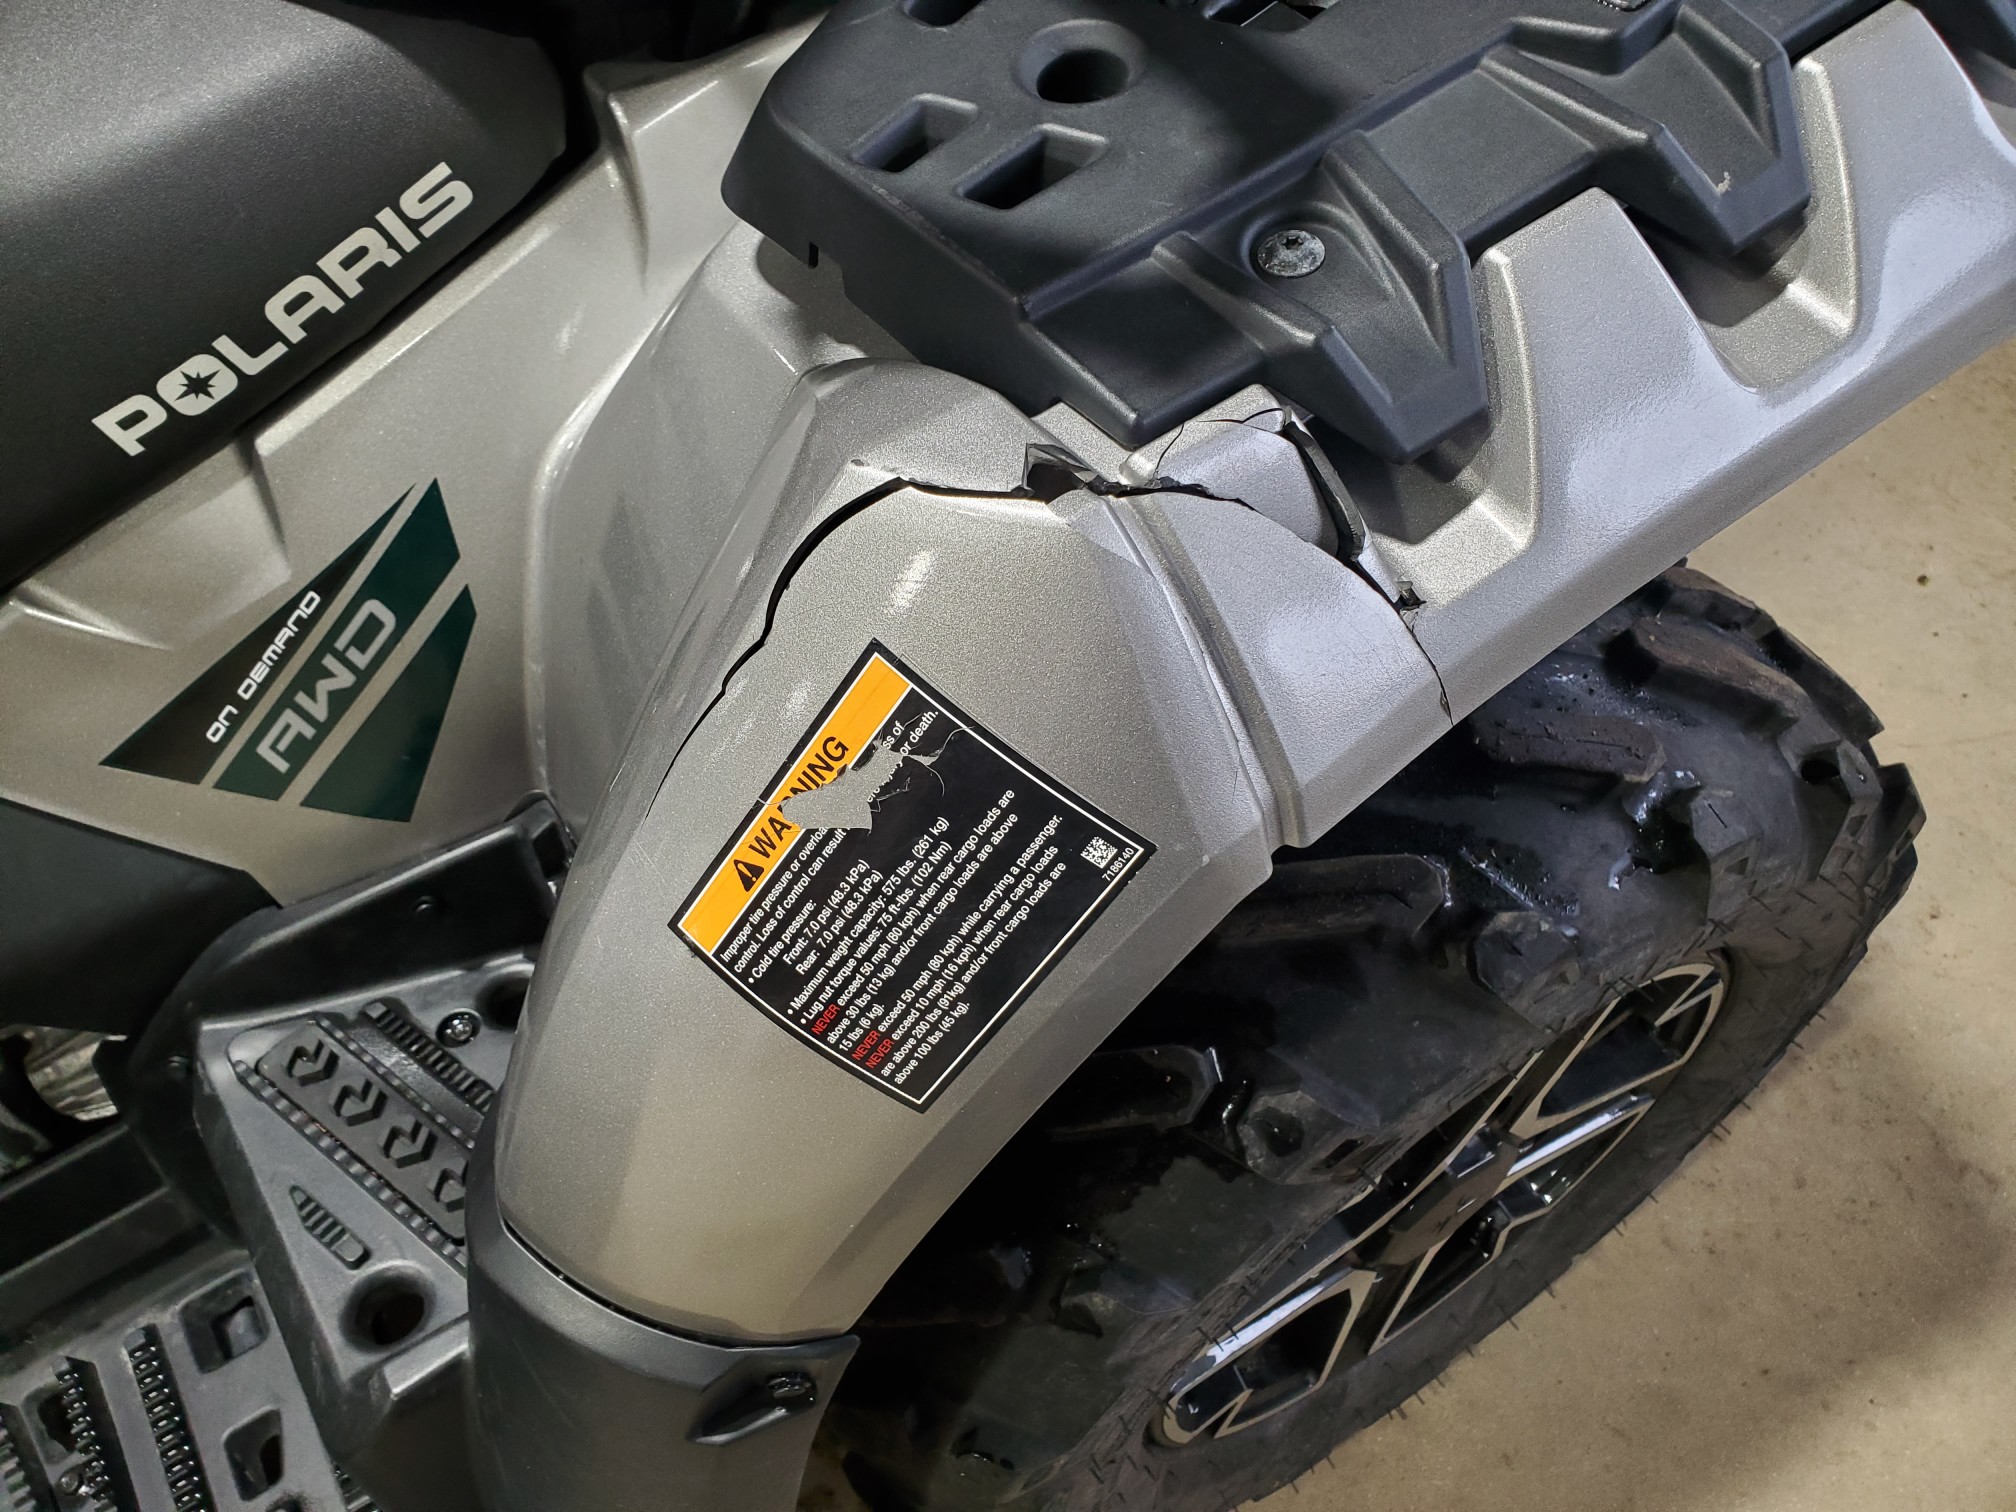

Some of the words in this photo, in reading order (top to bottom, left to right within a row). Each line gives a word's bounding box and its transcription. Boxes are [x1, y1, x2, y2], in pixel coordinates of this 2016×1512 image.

[91, 161, 473, 457] POLARIS
[206, 704, 239, 744] ON
[237, 590, 321, 700] DEMAND
[256, 598, 397, 774] AWD
[719, 921, 753, 963] Improper
[748, 908, 765, 925] tire
[760, 870, 793, 913] pressure
[789, 858, 801, 872] or
[798, 821, 830, 861] overloa
[893, 720, 905, 737] of
[733, 939, 762, 973] control.
[755, 917, 778, 943] Loss
[774, 904, 787, 920] of
[783, 872, 811, 909] control
[807, 856, 826, 877] can
[821, 825, 847, 859] result
[900, 743, 912, 756] or
[910, 709, 939, 743] death.
[782, 936, 810, 965] Front:
[802, 920, 821, 938] 7.0
[816, 904, 833, 925] psi
[827, 881, 851, 909] (48.3
[845, 858, 870, 885] kPa)
[789, 966, 830, 1011] Maximum
[824, 935, 854, 968] weight
[849, 894, 887, 938] capacity:
[881, 873, 902, 896] 575
[895, 859, 917, 878] lbs.
[911, 834, 934, 859] (261
[928, 816, 950, 837] kg)
[794, 949, 821, 976] Rear:
[815, 930, 834, 949] 7.0
[829, 914, 847, 936] psi
[840, 891, 865, 919] (48.3
[858, 869, 884, 895] kPa)
[802, 1000, 825, 1020] Lug
[818, 985, 835, 1003] nut
[828, 957, 858, 988] torque
[853, 926, 883, 959] values:
[876, 911, 893, 928] 75
[887, 887, 917, 915] ft-lbs.
[910, 861, 934, 887] (102
[927, 840, 953, 865] Nm)
[811, 1003, 841, 1035] NEVER
[836, 972, 866, 1007] exceed
[859, 961, 875, 976] 50
[870, 942, 892, 965] mph
[885, 926, 903, 945] (80
[897, 906, 922, 930] kph)
[915, 882, 941, 909] when
[936, 861, 956, 884] rear
[953, 834, 979, 864] cargo
[972, 807, 1002, 836] loads
[997, 789, 1015, 809] are
[826, 1017, 851, 1044] above
[845, 1005, 860, 1019] 30
[853, 992, 872, 1008] lbs
[865, 977, 883, 995] (13
[876, 963, 897, 981] kg)
[891, 934, 919, 966] and/or
[912, 912, 937, 937] front
[933, 887, 959, 915] cargo
[952, 860, 980, 889] loads
[976, 844, 994, 862] are
[990, 813, 1018, 846] above
[1101, 847, 1135, 882] 7186140
[751, 953, 773, 979] Cold
[767, 940, 785, 958] tire
[780, 899, 817, 945] pressure:
[838, 1038, 853, 1052] 15
[846, 1026, 864, 1042] lbs
[858, 1016, 872, 1029] (6
[865, 1003, 885, 1020] kg).
[851, 1030, 881, 1061] NEVER
[877, 999, 907, 1033] exceed
[900, 988, 916, 1003] 50
[912, 969, 933, 992] mph
[927, 954, 945, 972] (80
[938, 934, 964, 957] kph)
[957, 911, 982, 936] while
[978, 873, 1015, 912] carrying
[1009, 865, 1021, 875] a
[1015, 814, 1063, 869] passenger.
[865, 1038, 895, 1069] NEVER
[891, 1008, 921, 1041] exceed
[915, 997, 930, 1010] 10
[925, 978, 947, 1000] mph
[941, 962, 959, 981] (16
[952, 943, 977, 966] kph)
[971, 919, 997, 945] when
[992, 899, 1013, 921] rear
[1009, 873, 1036, 901] cargo
[1029, 845, 1059, 874] loads
[880, 1061, 896, 1077] are
[892, 1037, 917, 1064] above
[911, 1020, 931, 1039] 200
[924, 1007, 943, 1023] lbs
[936, 981, 967, 1010] (91kg)
[961, 952, 989, 984] and/or
[983, 931, 1009, 955] front
[1004, 905, 1030, 933] cargo
[1024, 878, 1053, 907] loads
[1049, 862, 1067, 880] are
[894, 1059, 919, 1085] above
[913, 1042, 932, 1060] 100
[925, 1030, 944, 1045] lbs
[937, 1015, 956, 1033] (45
[949, 1001, 970, 1018] kg).
